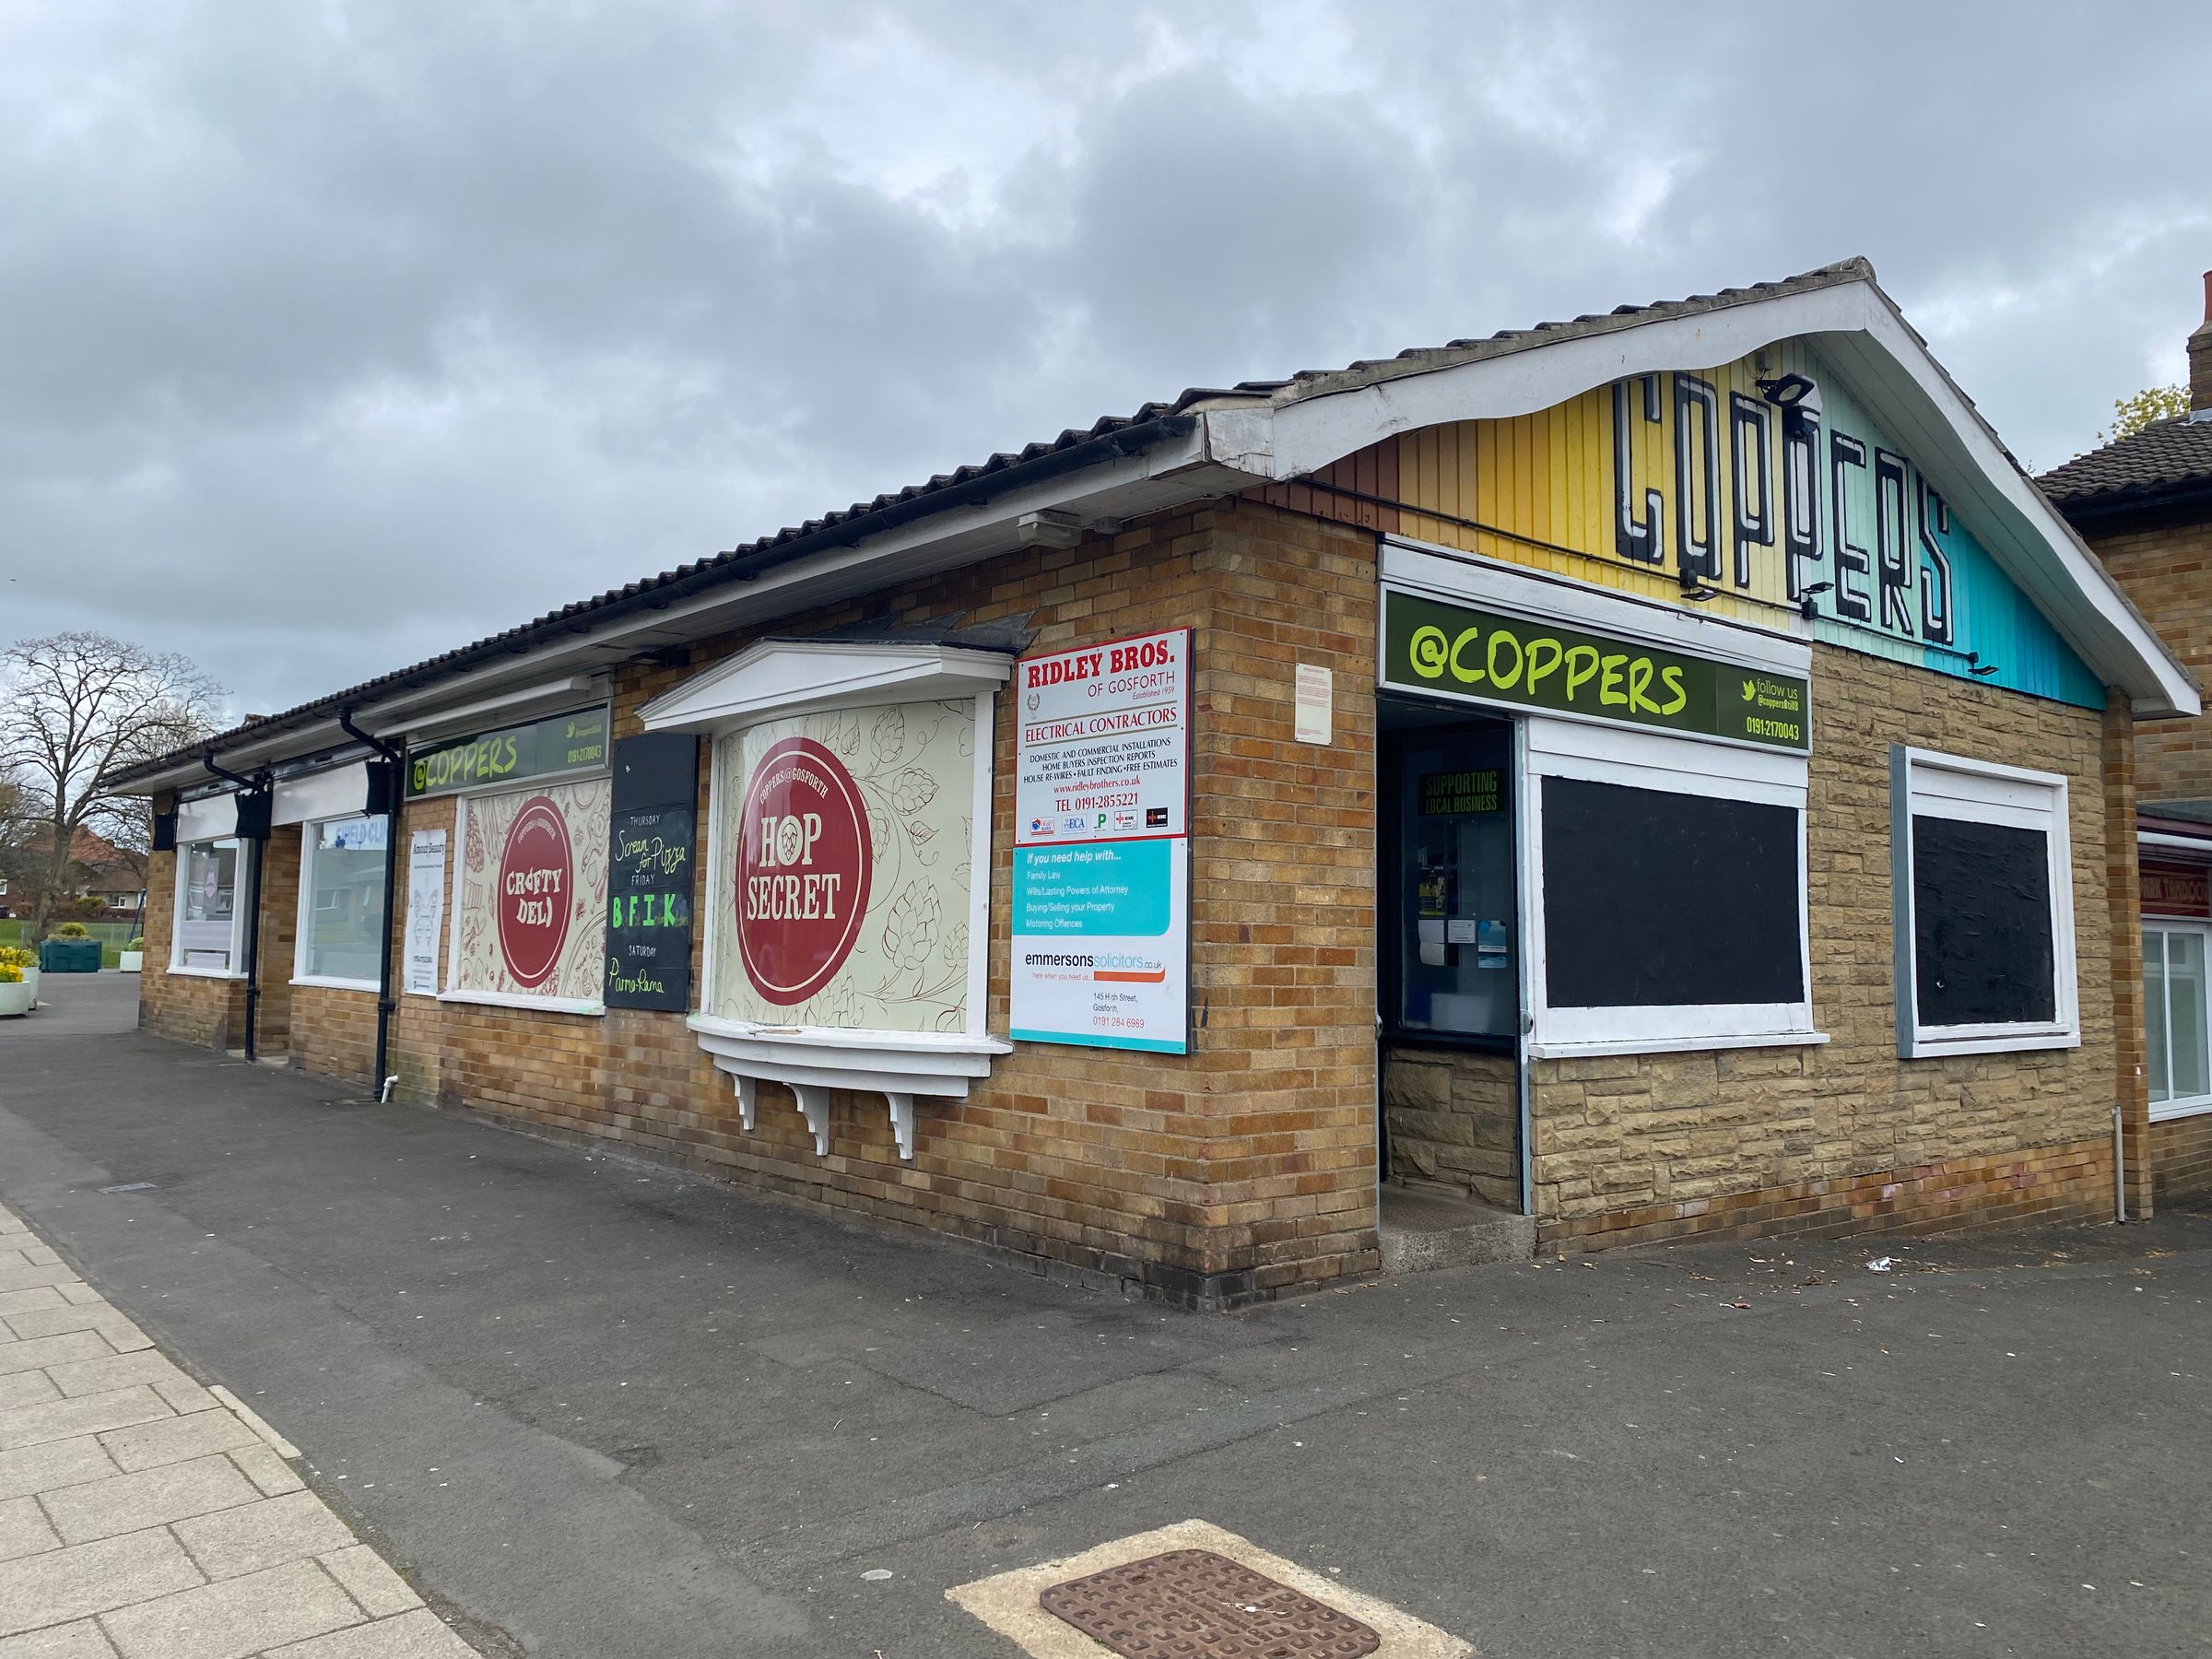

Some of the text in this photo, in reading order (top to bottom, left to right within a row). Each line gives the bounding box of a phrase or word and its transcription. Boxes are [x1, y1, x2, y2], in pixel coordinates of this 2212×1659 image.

[1613, 371, 1953, 645] COPPERS
[1028, 640, 1175, 688] RIDLEY BROS.
[1410, 625, 1687, 716] @COPPERS
[1088, 671, 1175, 698] OF GOSFORTH
[1133, 687, 1174, 700] Established 1959
[1757, 678, 1798, 699] follow us
[1026, 707, 1177, 743] ELECTRICAL CONTRACTORS
[1747, 716, 1799, 741] 0191-2170043
[1030, 737, 1171, 763] DOMESTIC AND COMMERCIAL INSTALLATIONS
[1042, 750, 1156, 771] HOME BUYERS INSPECTION REPORTS
[414, 735, 517, 791] @COPPERS
[1023, 774, 1043, 783] HOUSE
[1045, 771, 1072, 782] RE-WIRES
[1077, 768, 1094, 778] FAULT
[1096, 765, 1123, 775] FINDING
[1143, 759, 1178, 771] ESTIMATES
[1053, 775, 1141, 794] www.ridleybrothers.co.uk
[1426, 771, 1498, 797] SUPPORTING
[1055, 793, 1138, 812] TEL 0191-2855221
[1425, 794, 1498, 815] LOCAL BUSINESS
[630, 814, 661, 827] THURSDAY
[1069, 818, 1085, 830] ECA
[615, 830, 649, 862] Scream
[759, 813, 822, 867] HOP
[635, 836, 686, 875] for Pizza
[1027, 849, 1121, 865] If you need help with...
[631, 874, 655, 886] FRIDAY
[1027, 870, 1061, 881] Family Law
[747, 874, 841, 921] SECRET
[1027, 885, 1128, 897] Wills/Lasting Powers of Attorney
[1026, 901, 1115, 913] Buying/Selling your Property
[1026, 919, 1083, 929] Motoring Offences
[629, 945, 656, 958] SATURDAY
[1093, 993, 1138, 1003] 145 High Street,
[1093, 1016, 1145, 1029] 0191 284 6989
